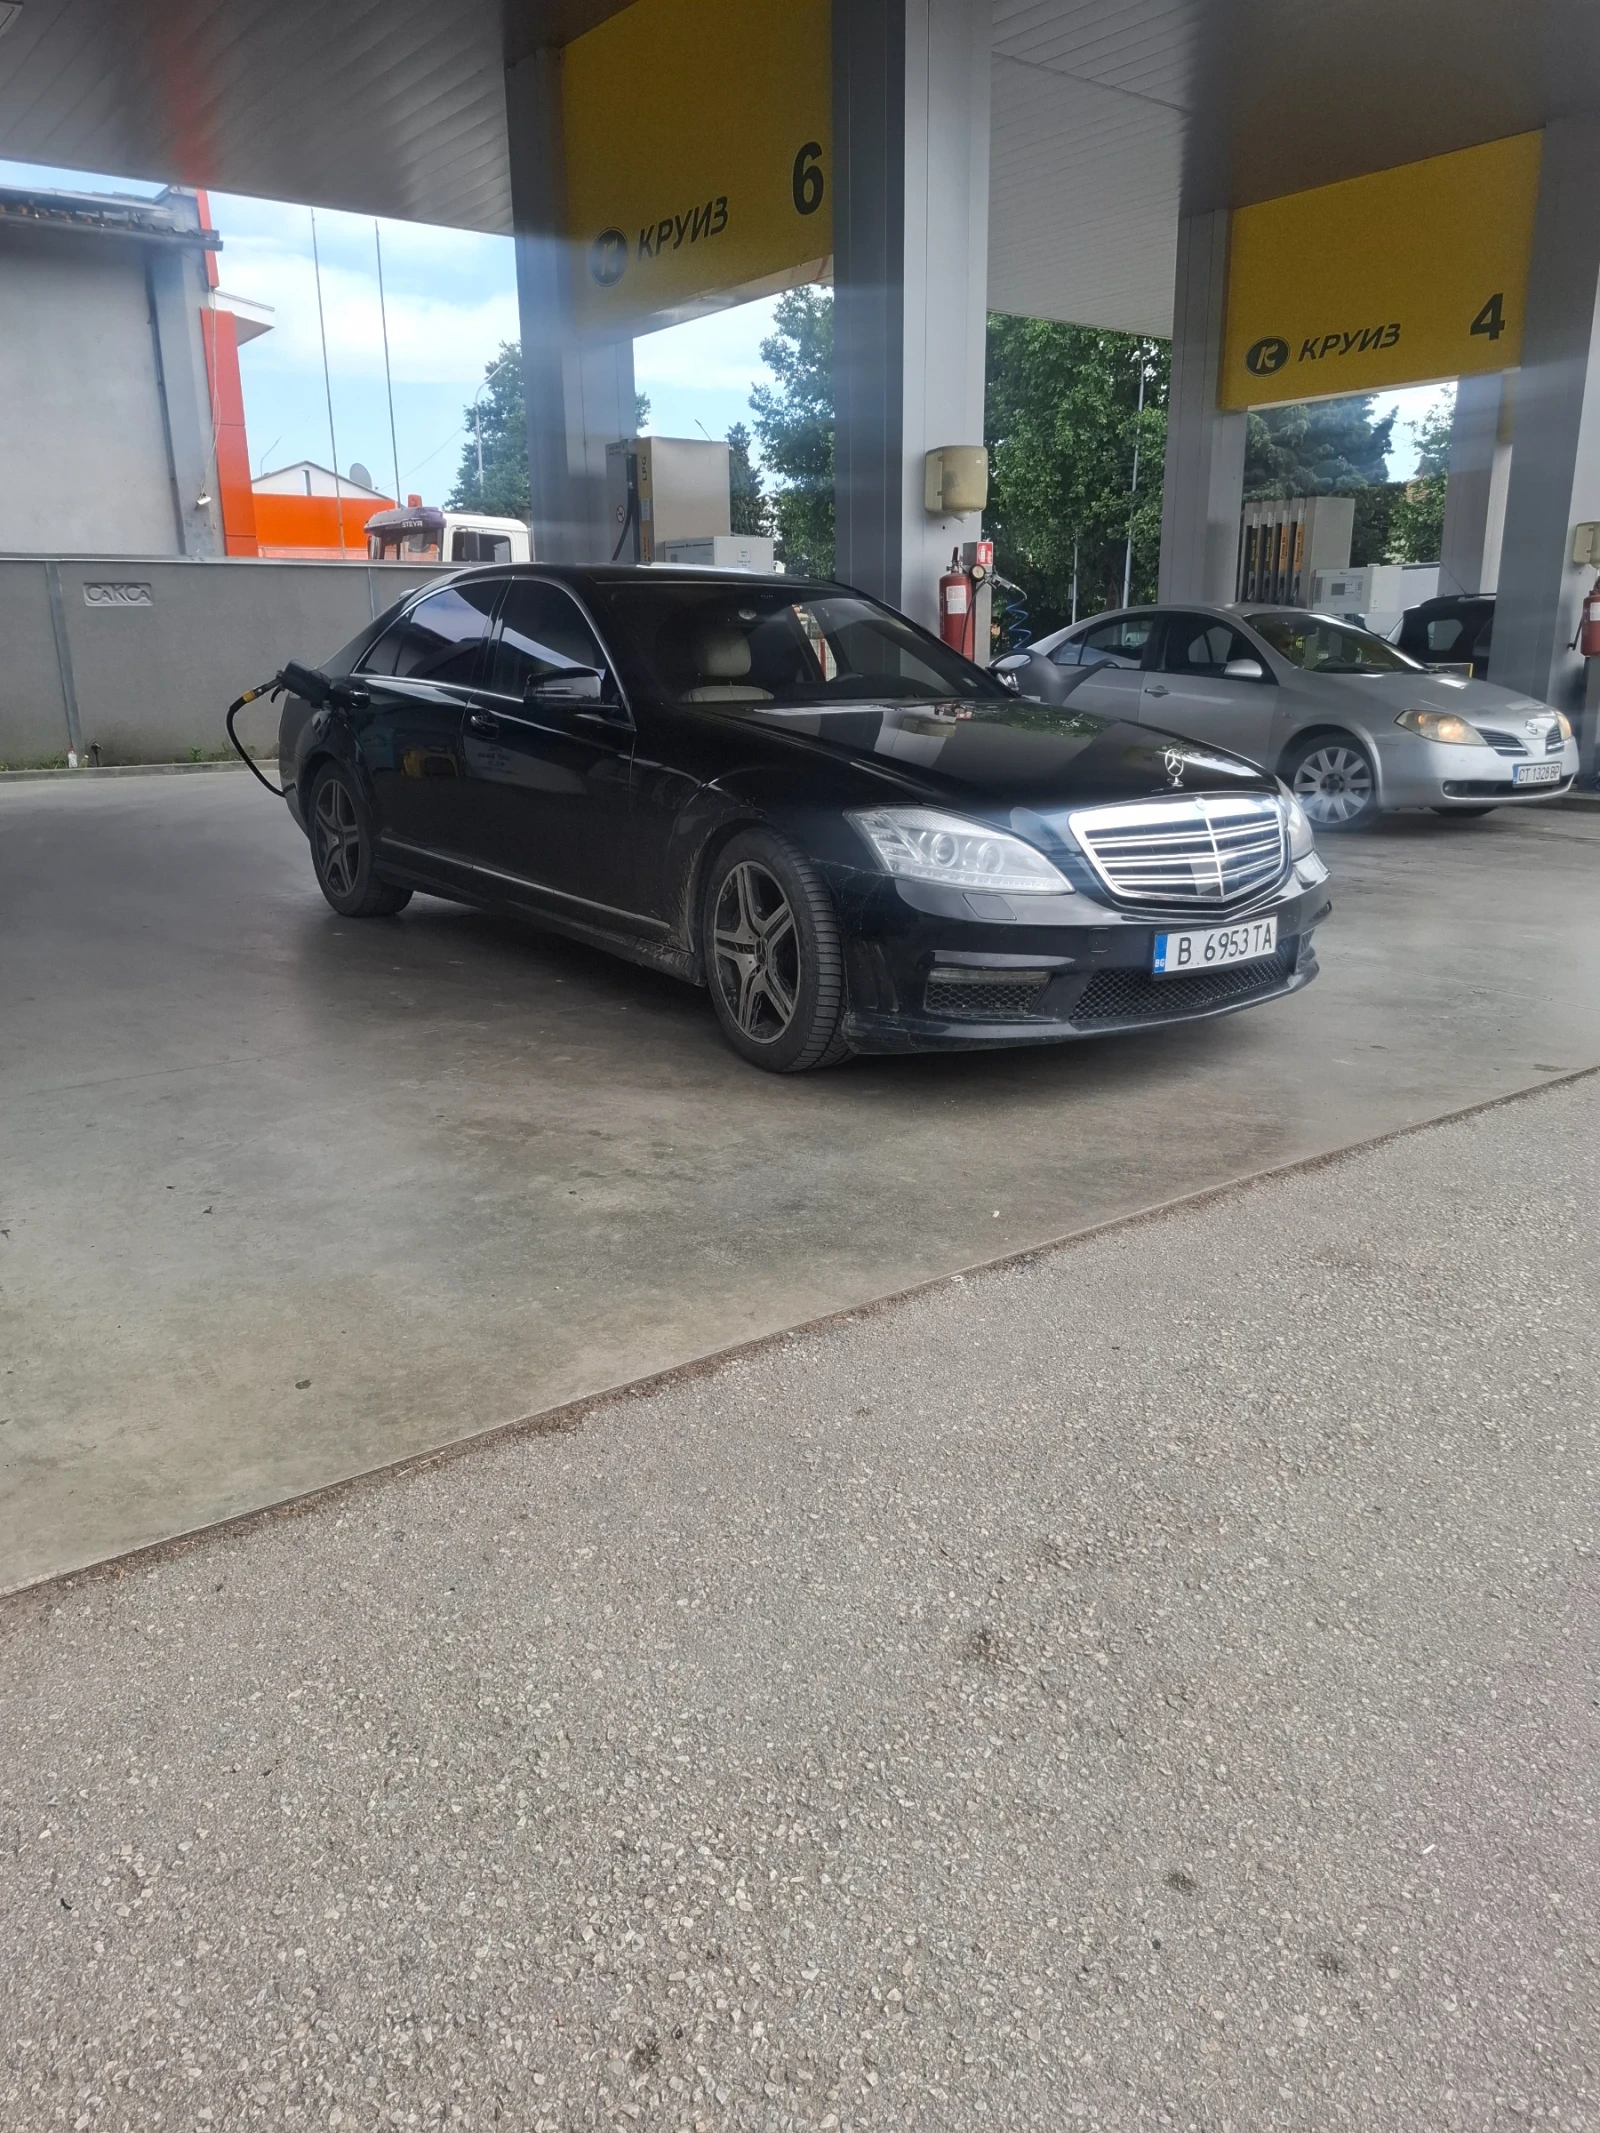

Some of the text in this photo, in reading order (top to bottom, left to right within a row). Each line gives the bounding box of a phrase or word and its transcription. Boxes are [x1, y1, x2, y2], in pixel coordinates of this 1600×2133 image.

[793, 141, 824, 216] 6
[637, 196, 729, 262] КРУИЗ
[1469, 292, 1506, 341] 4
[1298, 323, 1401, 362] КРУИЗ
[1154, 958, 1165, 968] BG
[1177, 922, 1273, 966] B 6953 TA
